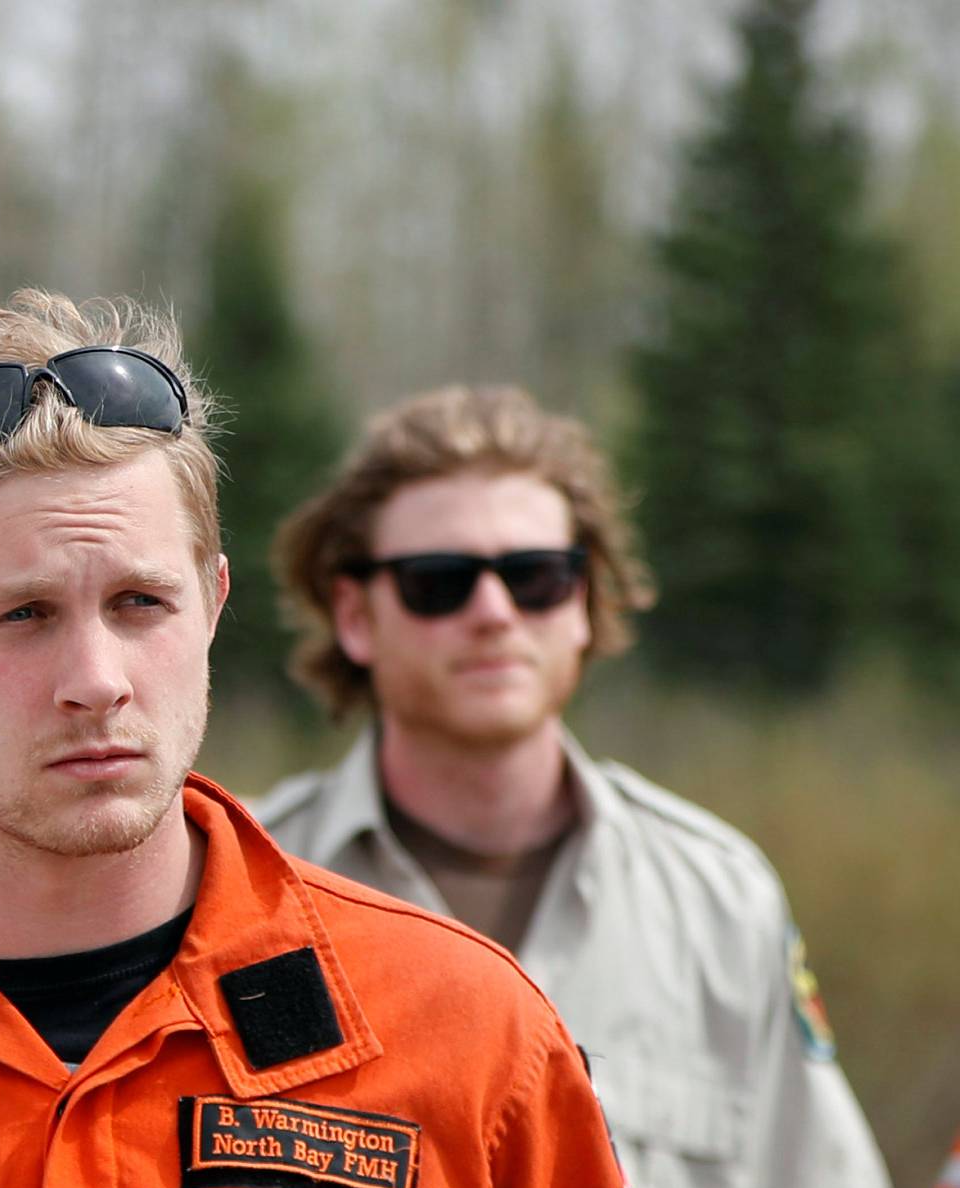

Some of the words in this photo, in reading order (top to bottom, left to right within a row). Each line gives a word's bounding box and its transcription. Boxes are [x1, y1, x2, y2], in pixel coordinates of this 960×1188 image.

[218, 1105, 240, 1127] B.
[251, 1108, 395, 1153] Warmington
[212, 1133, 283, 1157] North
[293, 1139, 334, 1172] Bay
[343, 1150, 399, 1182] FMH
